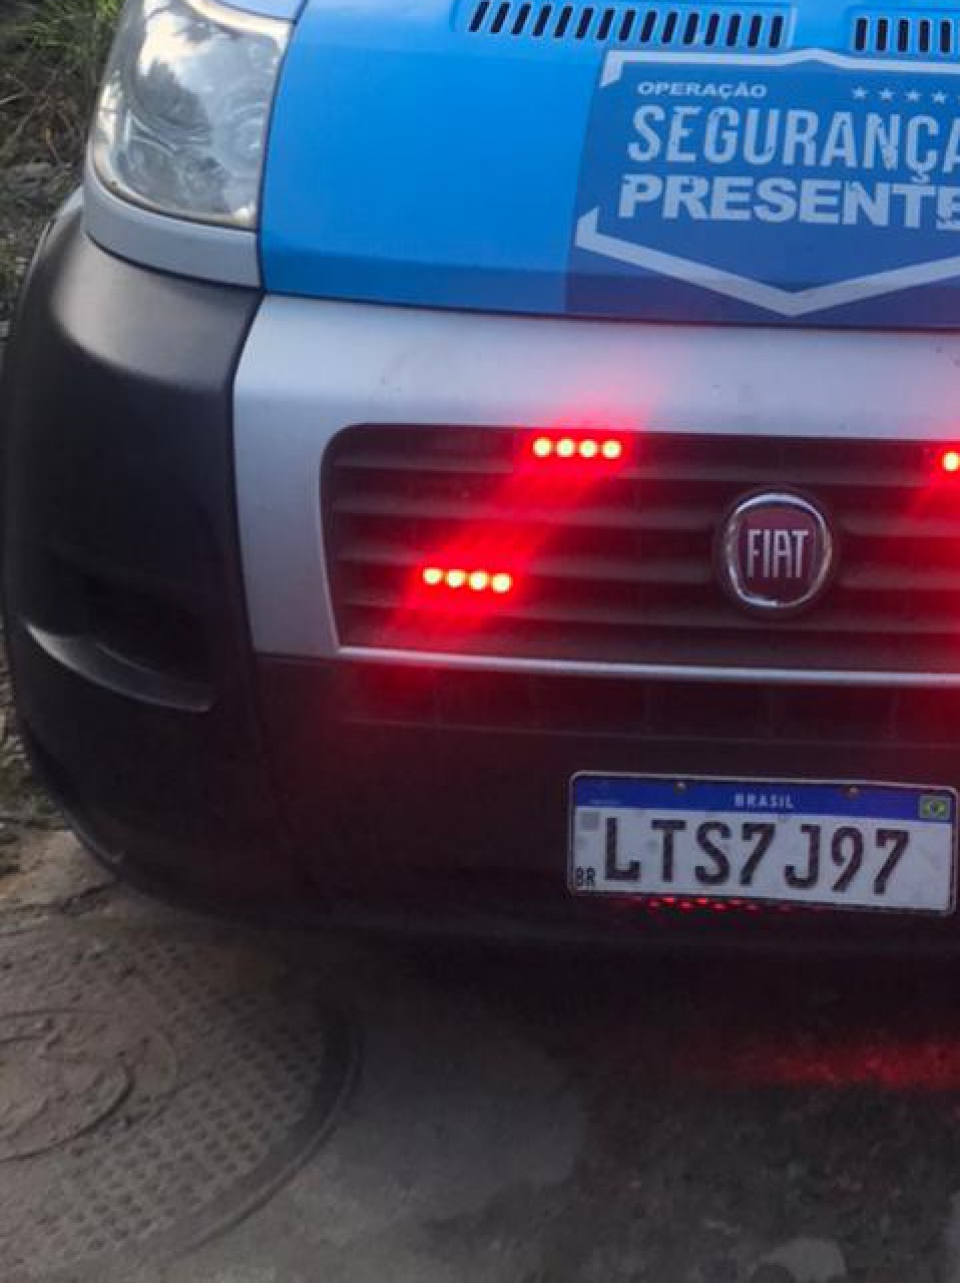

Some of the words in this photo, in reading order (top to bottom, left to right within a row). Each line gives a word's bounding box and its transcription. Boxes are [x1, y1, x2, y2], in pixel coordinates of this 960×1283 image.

[637, 81, 767, 100] OPERAÇÃO
[747, 528, 809, 578] FIAT
[734, 793, 795, 809] BRASIL
[604, 817, 910, 895] LTS7J97
